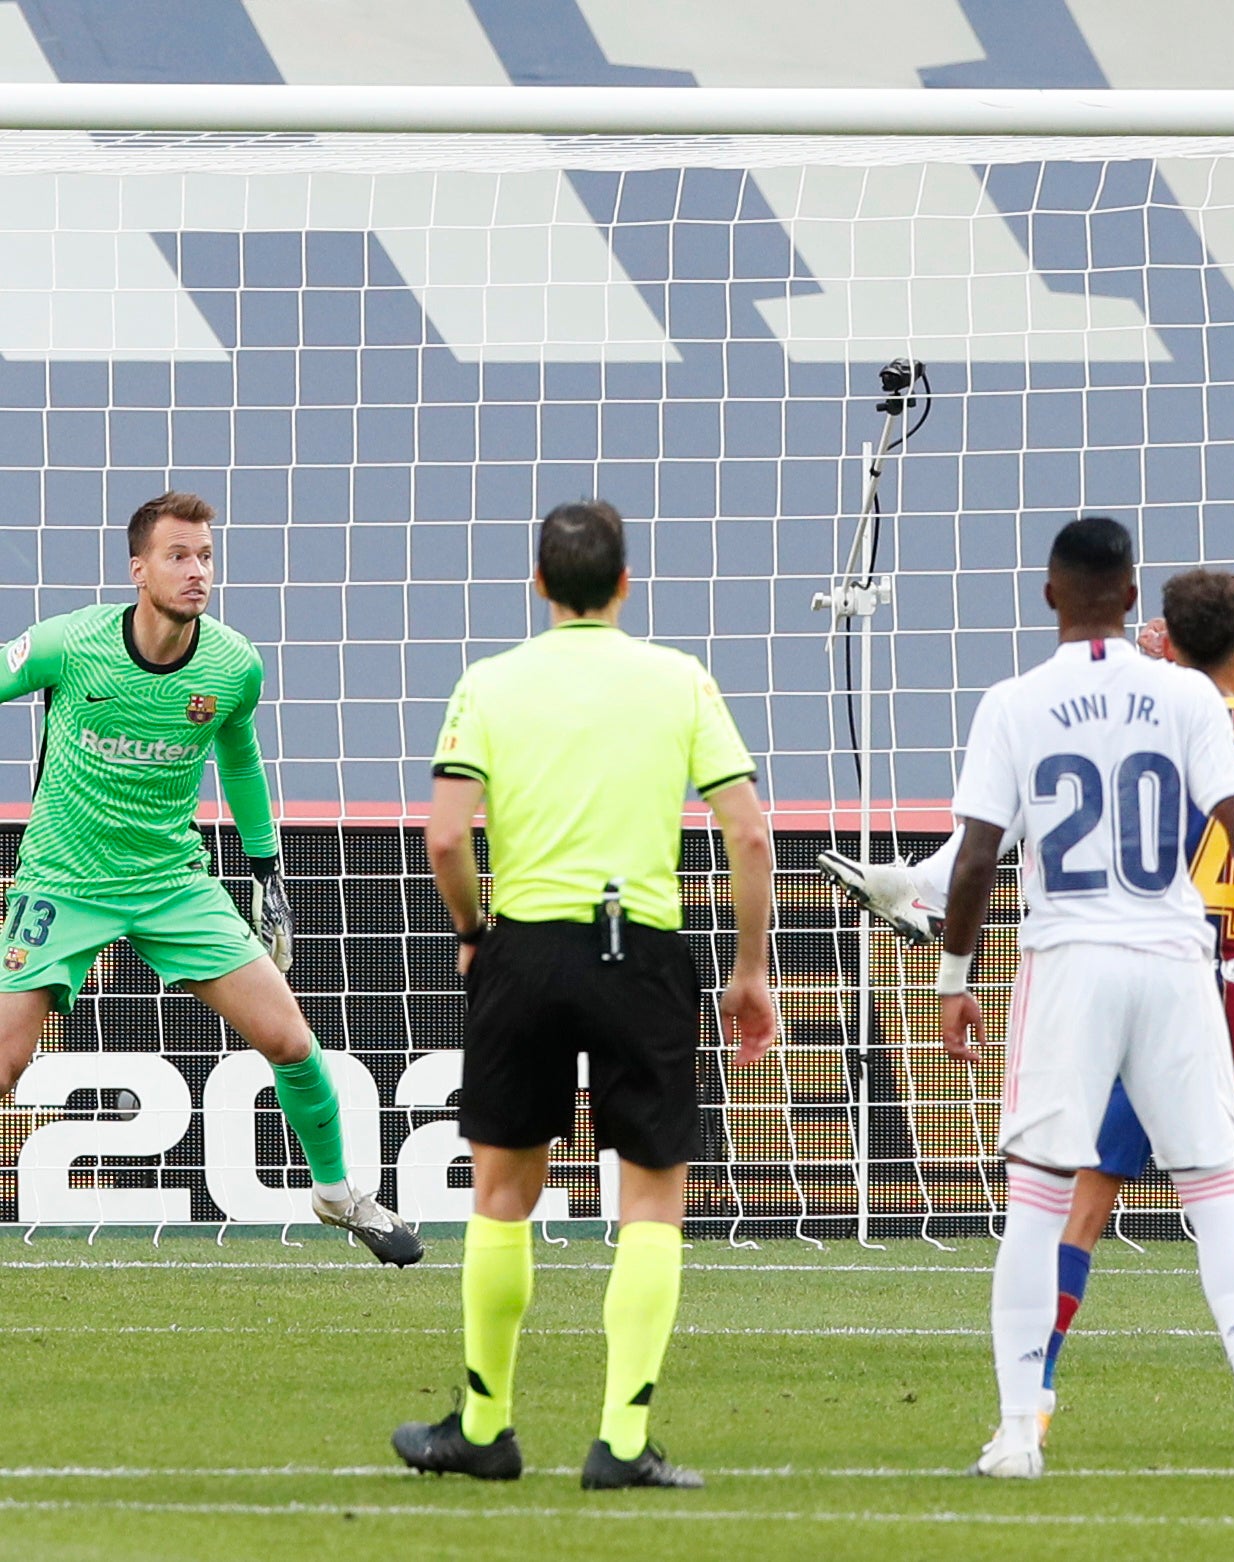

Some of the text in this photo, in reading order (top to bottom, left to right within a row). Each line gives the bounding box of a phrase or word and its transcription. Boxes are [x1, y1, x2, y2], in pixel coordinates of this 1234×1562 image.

[1050, 693, 1160, 729] VINI JR.
[80, 729, 200, 764] Rakuten
[1028, 752, 1182, 900] 20
[8, 895, 57, 948] 13
